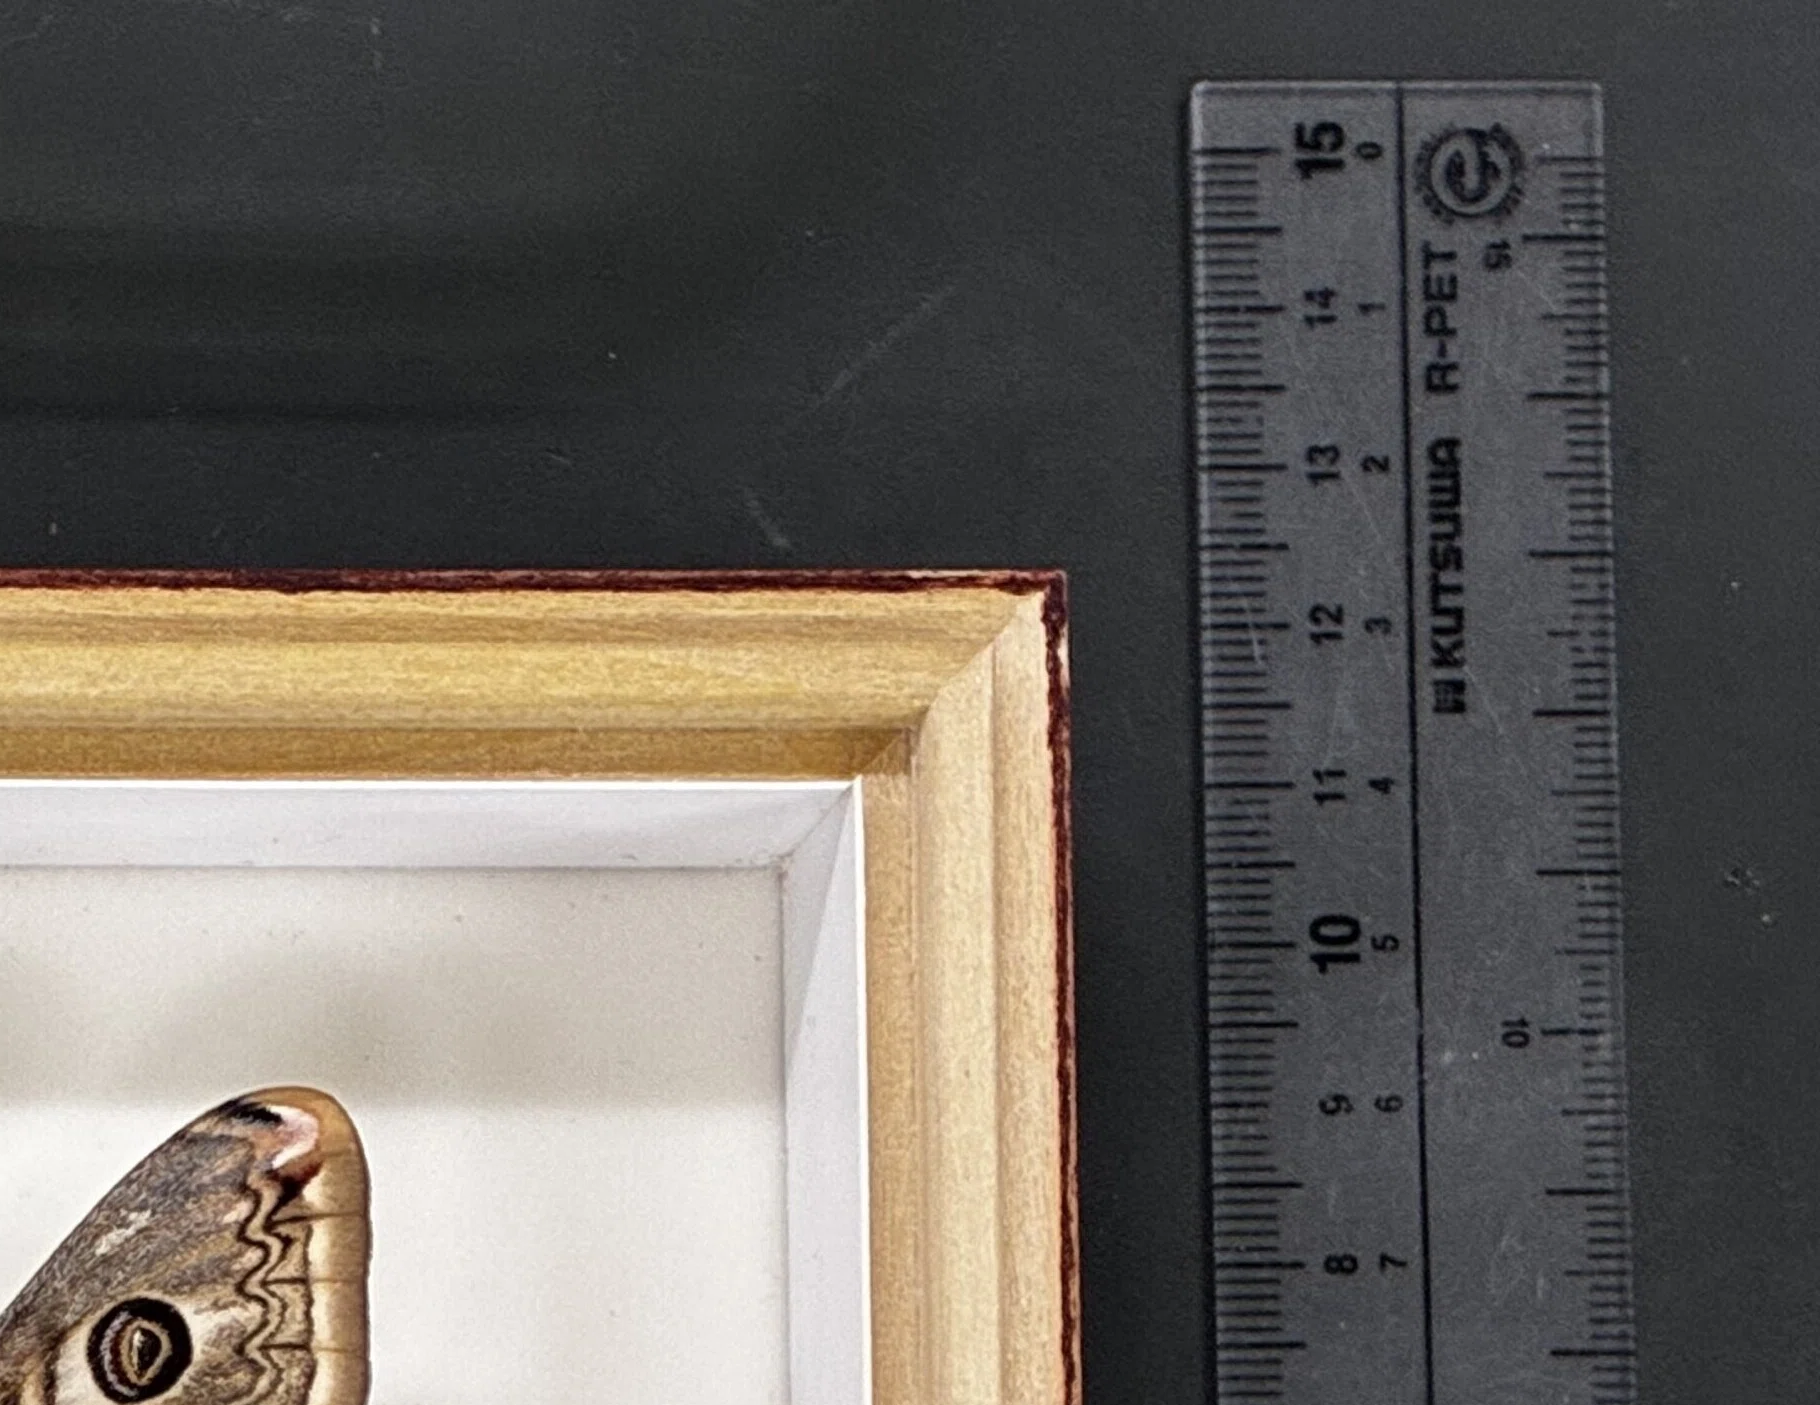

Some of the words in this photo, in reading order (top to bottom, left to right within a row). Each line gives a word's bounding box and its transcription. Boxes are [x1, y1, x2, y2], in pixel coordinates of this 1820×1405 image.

[1295, 121, 1345, 180] 15
[1355, 141, 1382, 160] 0
[1485, 239, 1512, 271] 15
[1303, 287, 1338, 329] 14
[1358, 302, 1386, 315] 1
[1422, 241, 1461, 395] R-PET
[1305, 444, 1342, 485] 13
[1361, 455, 1390, 473] 2
[1427, 436, 1466, 669] KUTSUWA
[1308, 603, 1344, 645] 12
[1364, 617, 1392, 635] 3
[1312, 768, 1347, 806] 11
[1368, 777, 1396, 794] 4
[1309, 914, 1361, 975] 10
[1371, 934, 1400, 952] 5
[1501, 1017, 1530, 1049] 10
[1318, 1094, 1354, 1116] 9
[1374, 1095, 1403, 1114] 6
[1323, 1253, 1359, 1275] 8
[1379, 1253, 1408, 1272] 7
